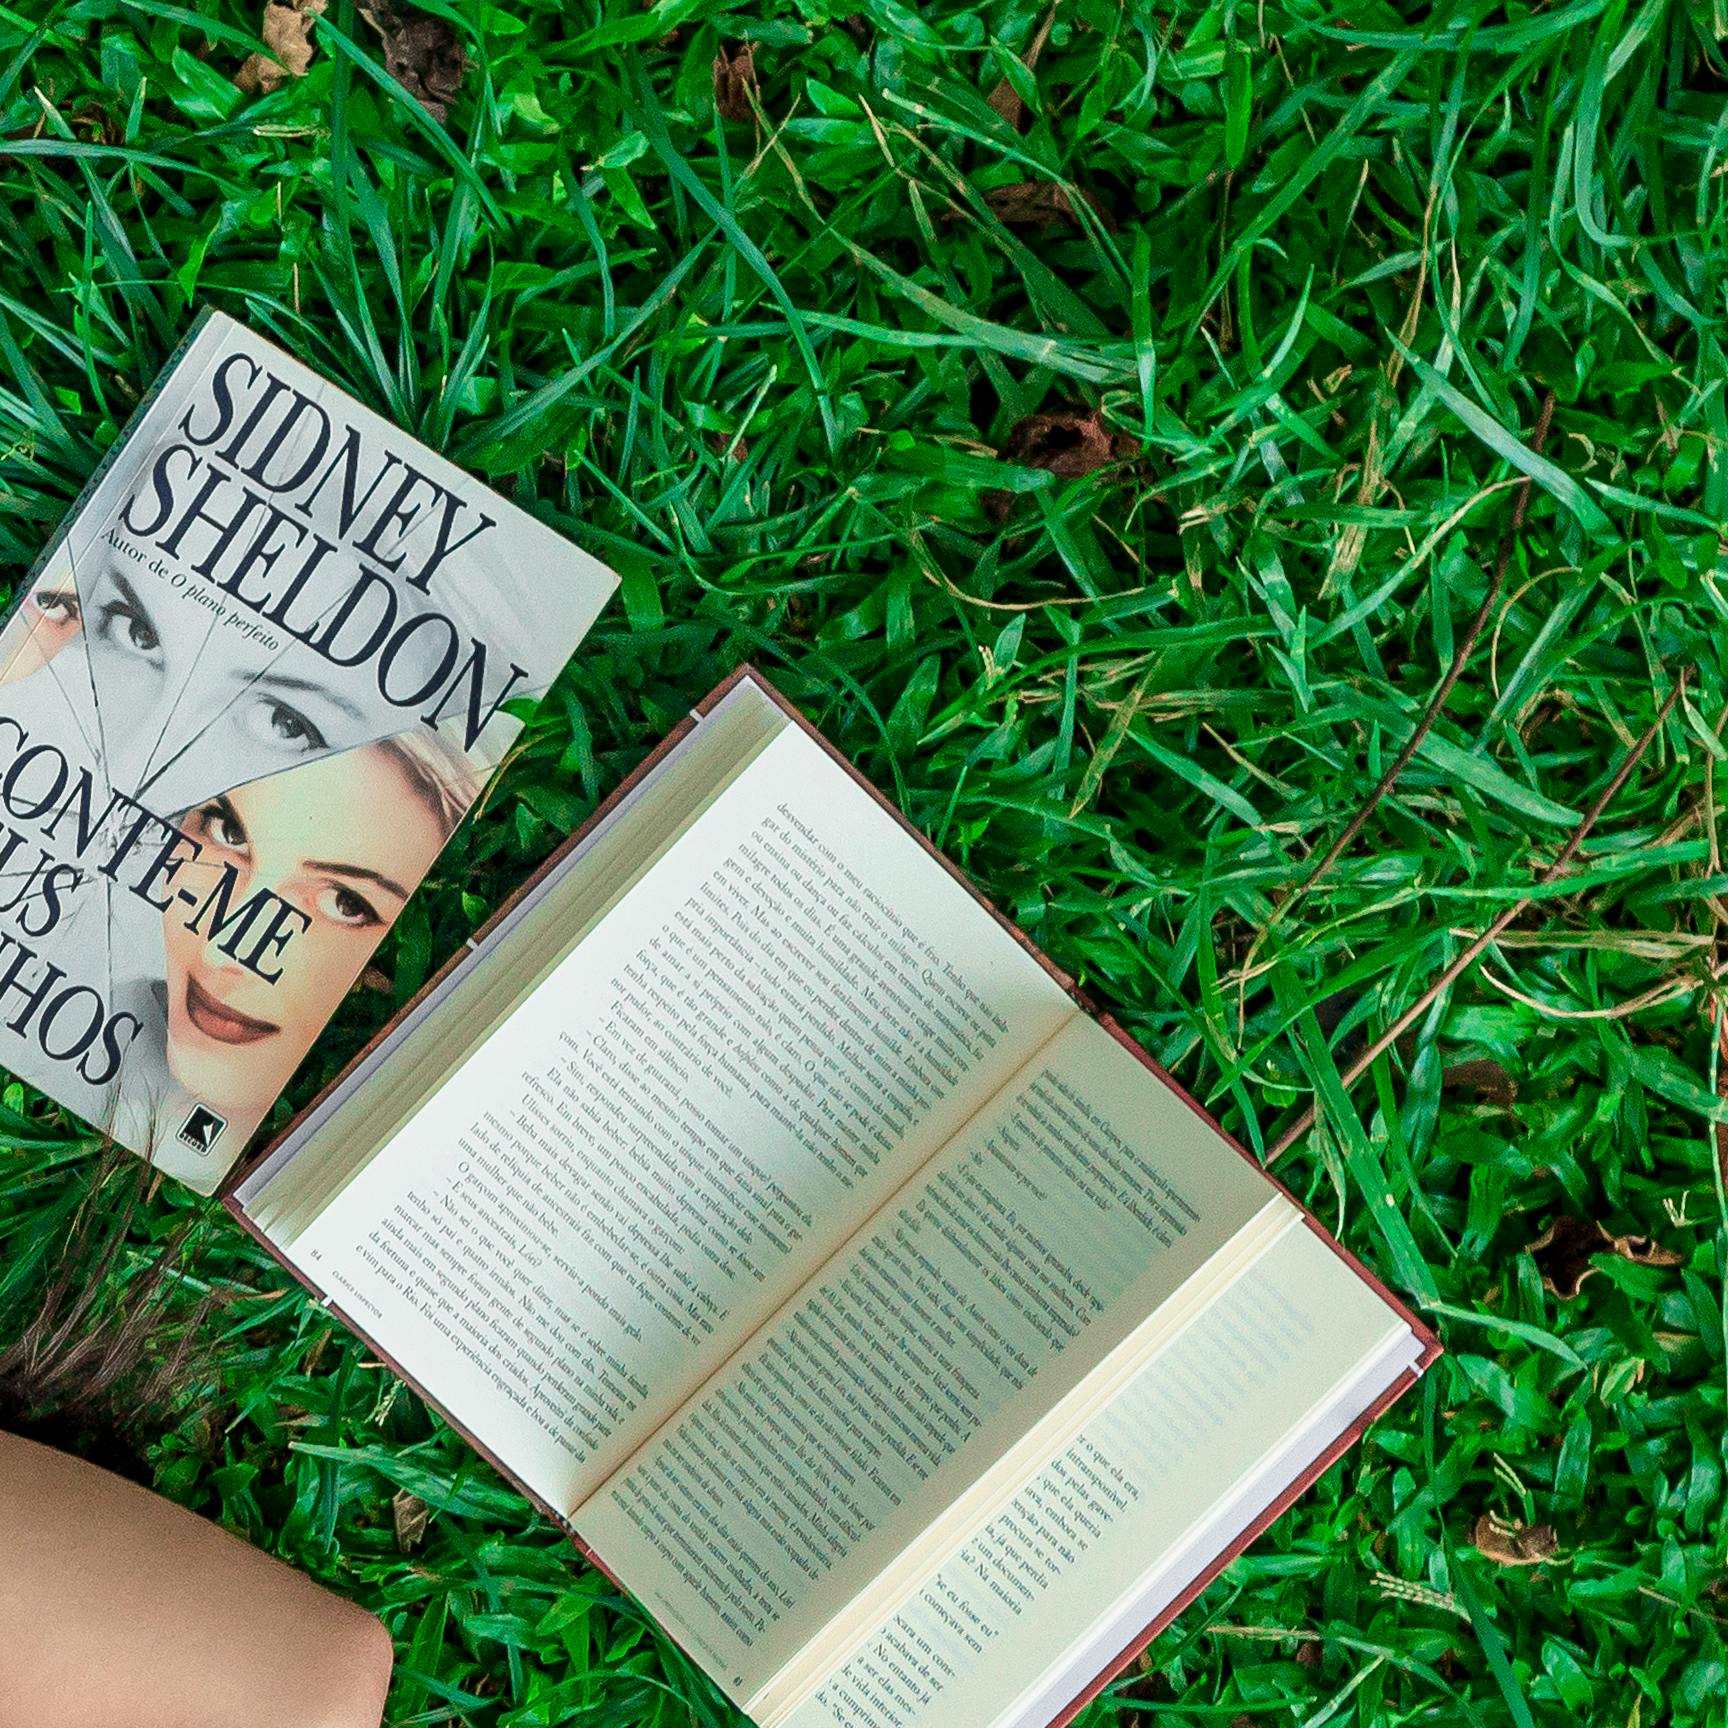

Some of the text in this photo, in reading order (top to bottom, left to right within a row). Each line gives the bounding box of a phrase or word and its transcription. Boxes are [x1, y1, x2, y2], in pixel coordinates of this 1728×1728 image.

[177, 351, 497, 597] SIDNEY
[101, 528, 280, 651] Autor de O plano perfeito
[121, 446, 529, 754] SHELDON
[610, 977, 628, 994] nor
[622, 991, 653, 1022] pudor,
[652, 1019, 666, 1032] ao
[664, 1029, 703, 1067] contrário
[700, 1064, 714, 1079] de
[610, 1000, 689, 1084] Ficaram em silêncio.
[457, 1137, 559, 1239] uma mulher que não bebe.
[521, 1092, 552, 1126] Ulisses
[549, 1124, 575, 1153] sorriu,
[576, 1149, 615, 1188] enquanto
[612, 1185, 649, 1221] chamava
[647, 1217, 656, 1227] o
[1050, 1459, 1114, 1523] dos pelas gave-
[946, 1590, 960, 1604] eu
[957, 1599, 981, 1625] fosse
[973, 1562, 1023, 1616] Na maioria
